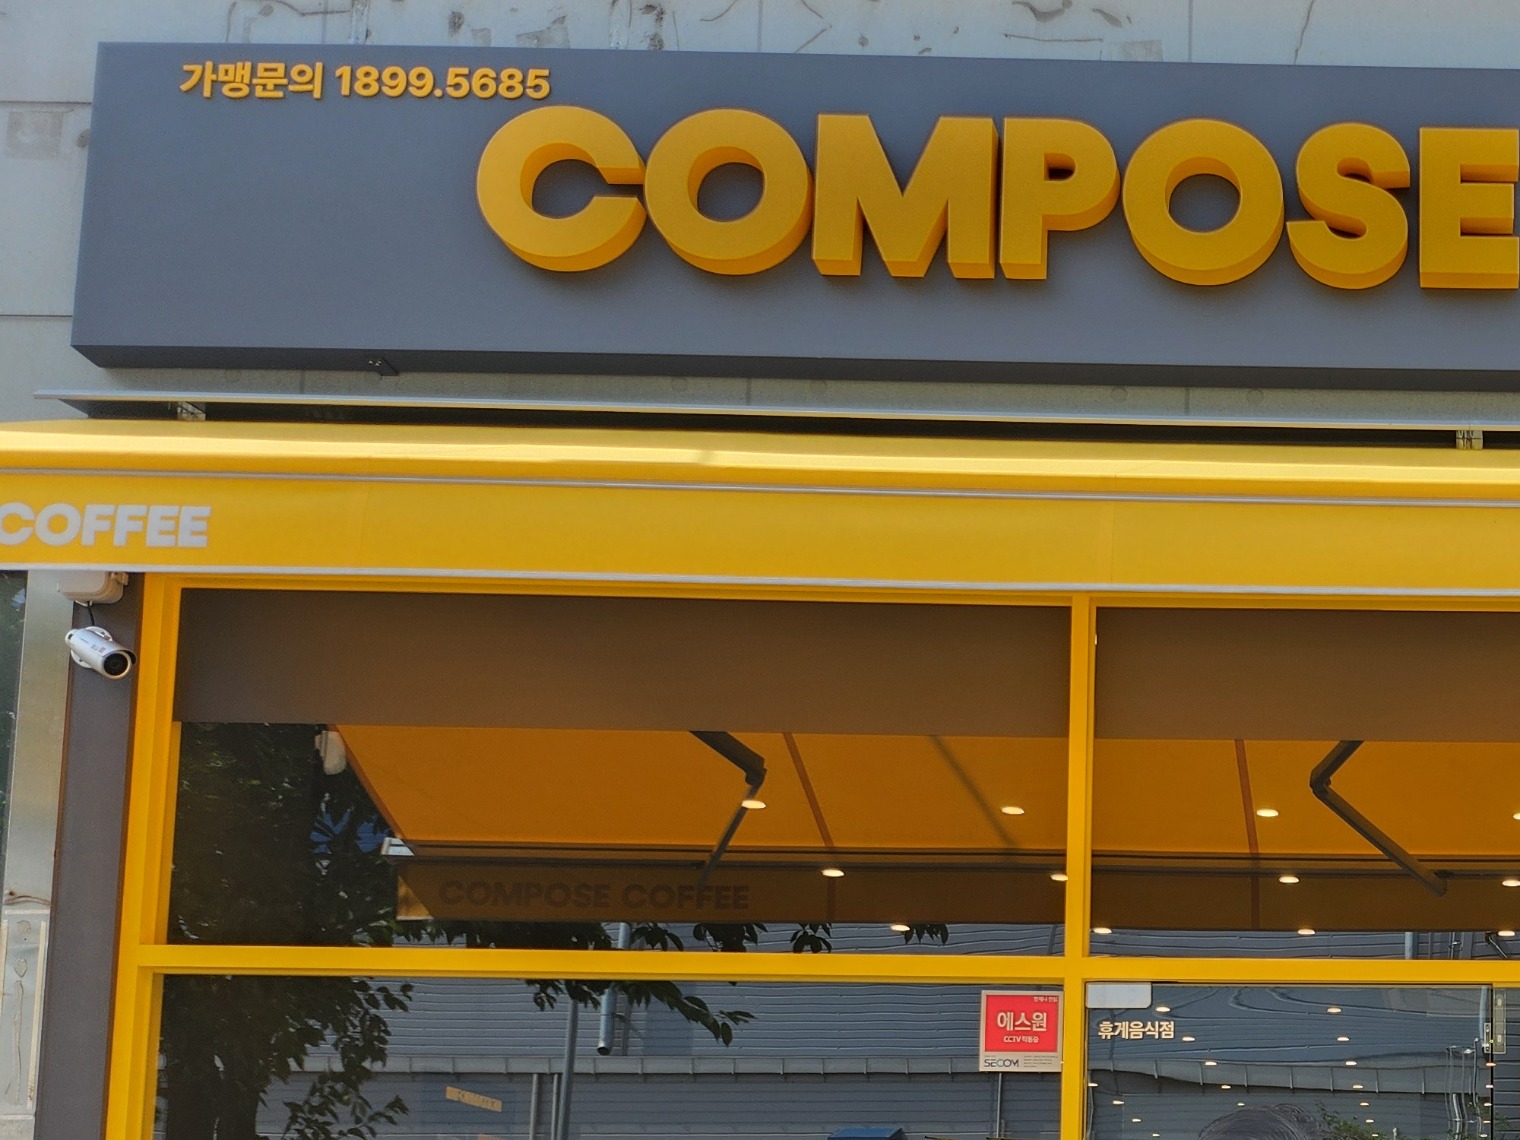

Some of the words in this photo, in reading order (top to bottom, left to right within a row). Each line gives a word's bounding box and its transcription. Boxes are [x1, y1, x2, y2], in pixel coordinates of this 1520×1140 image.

[180, 61, 324, 98] 가맹문의
[335, 66, 551, 99] 1899.5685
[476, 105, 1520, 291] COMPOSE
[0, 502, 212, 548] COFFEE
[438, 879, 611, 909] COMPOSE
[621, 883, 750, 911] COFFEE
[997, 1011, 1047, 1031] 에스원
[1098, 1021, 1175, 1039] 휴게음식점
[984, 1058, 1020, 1068] SECOM
